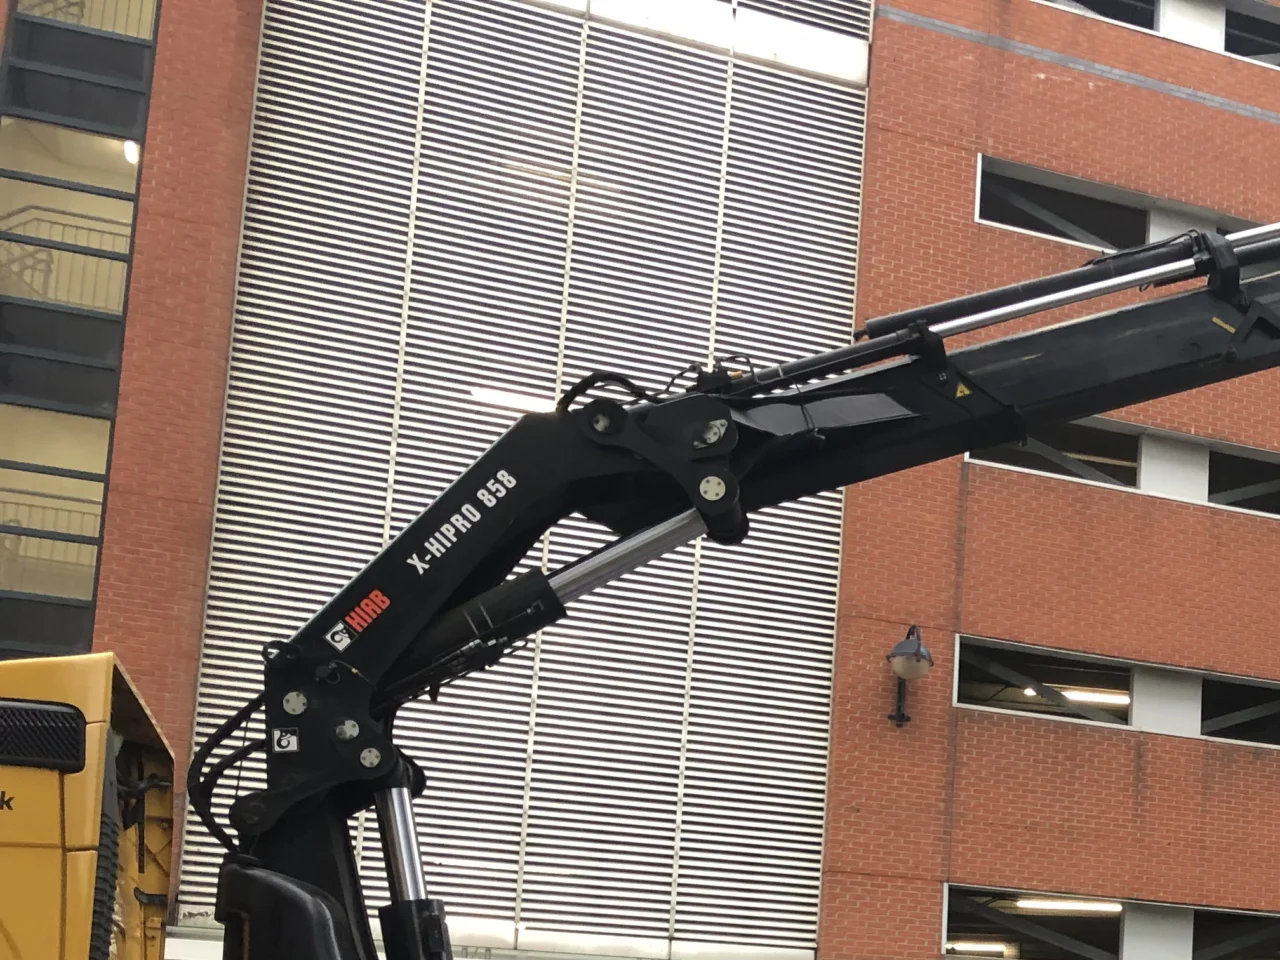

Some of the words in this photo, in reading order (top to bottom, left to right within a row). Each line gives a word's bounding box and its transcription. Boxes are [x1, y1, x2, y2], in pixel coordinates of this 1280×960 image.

[406, 503, 481, 575] X-HIPRO
[476, 469, 517, 508] 858
[344, 589, 391, 633] HIAB
